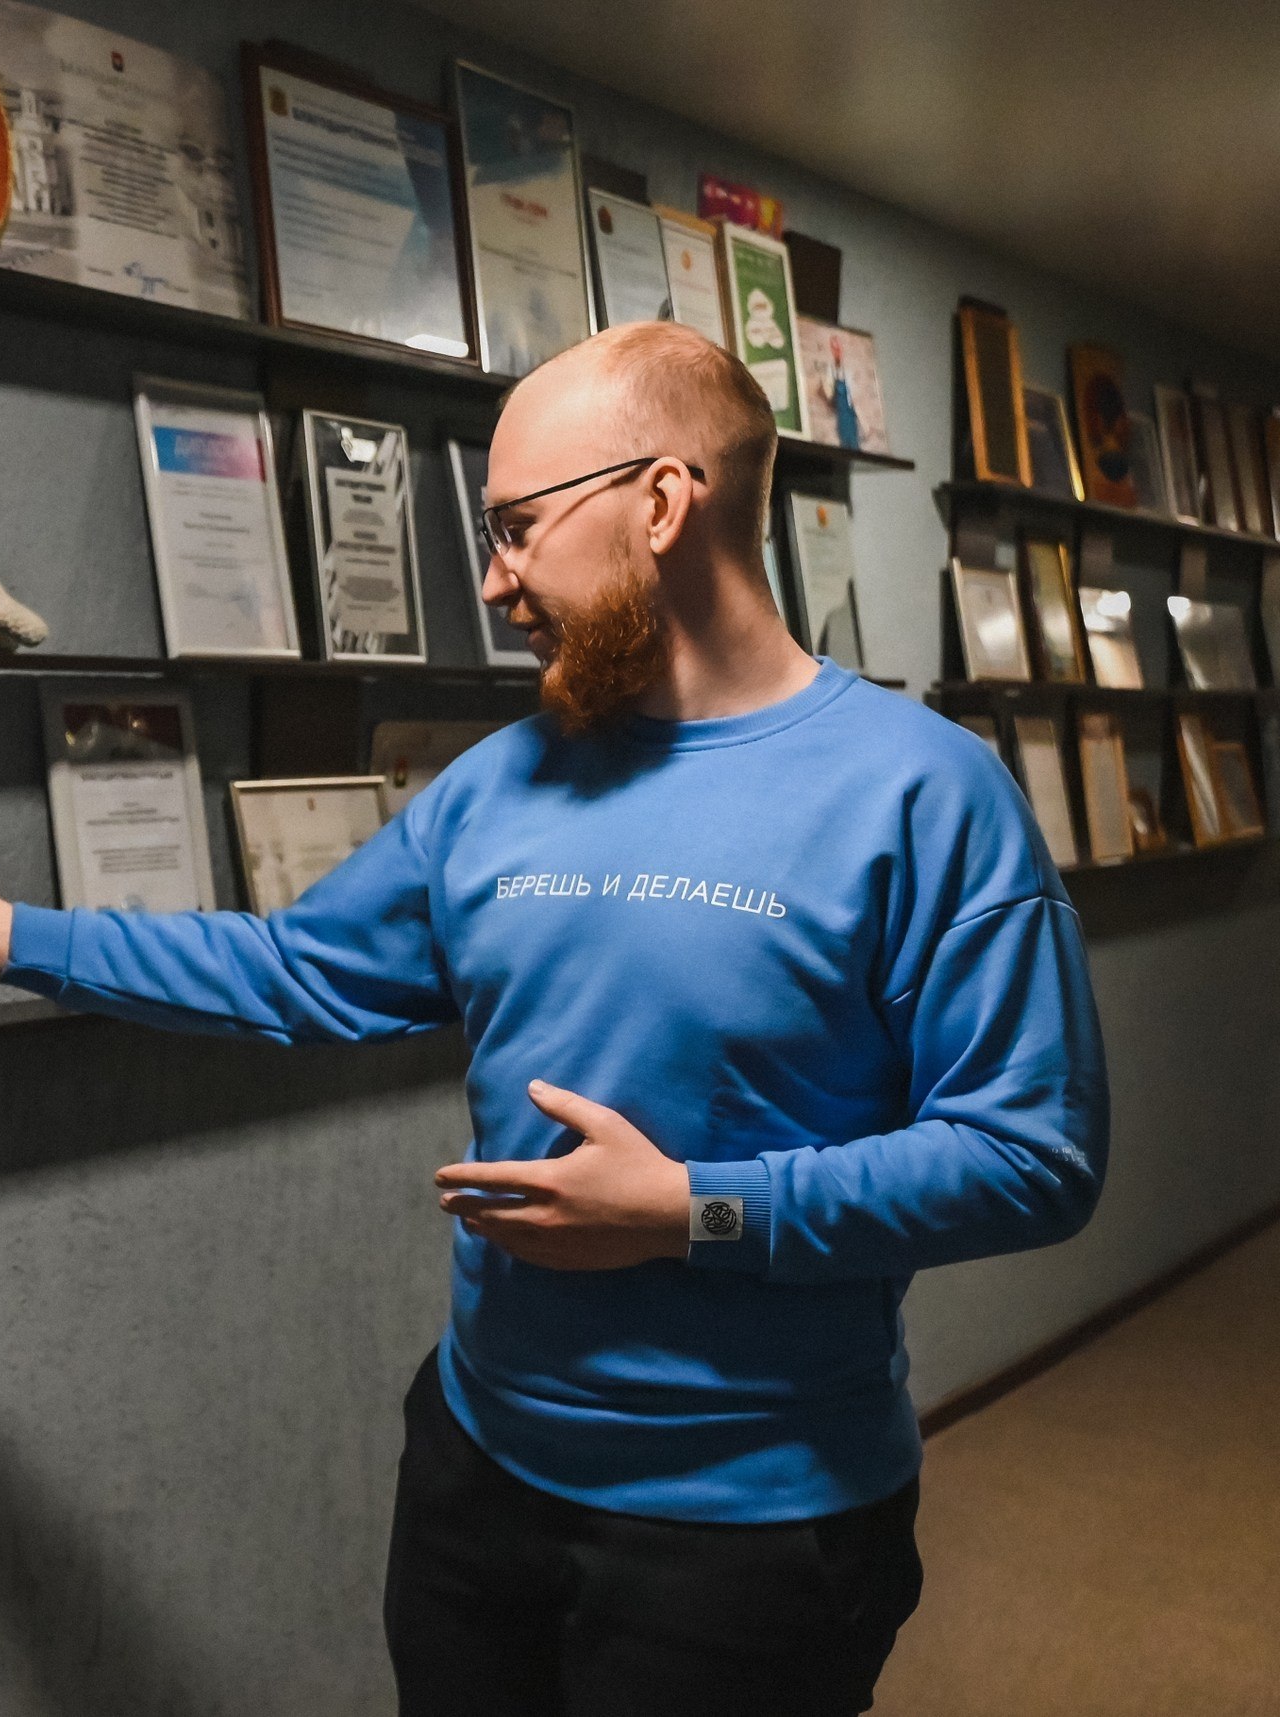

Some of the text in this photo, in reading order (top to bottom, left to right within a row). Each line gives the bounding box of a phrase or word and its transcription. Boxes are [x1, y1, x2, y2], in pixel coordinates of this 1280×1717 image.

[496, 873, 787, 919] БЕРЕШЬ И ДЕЛАЕШЬ
